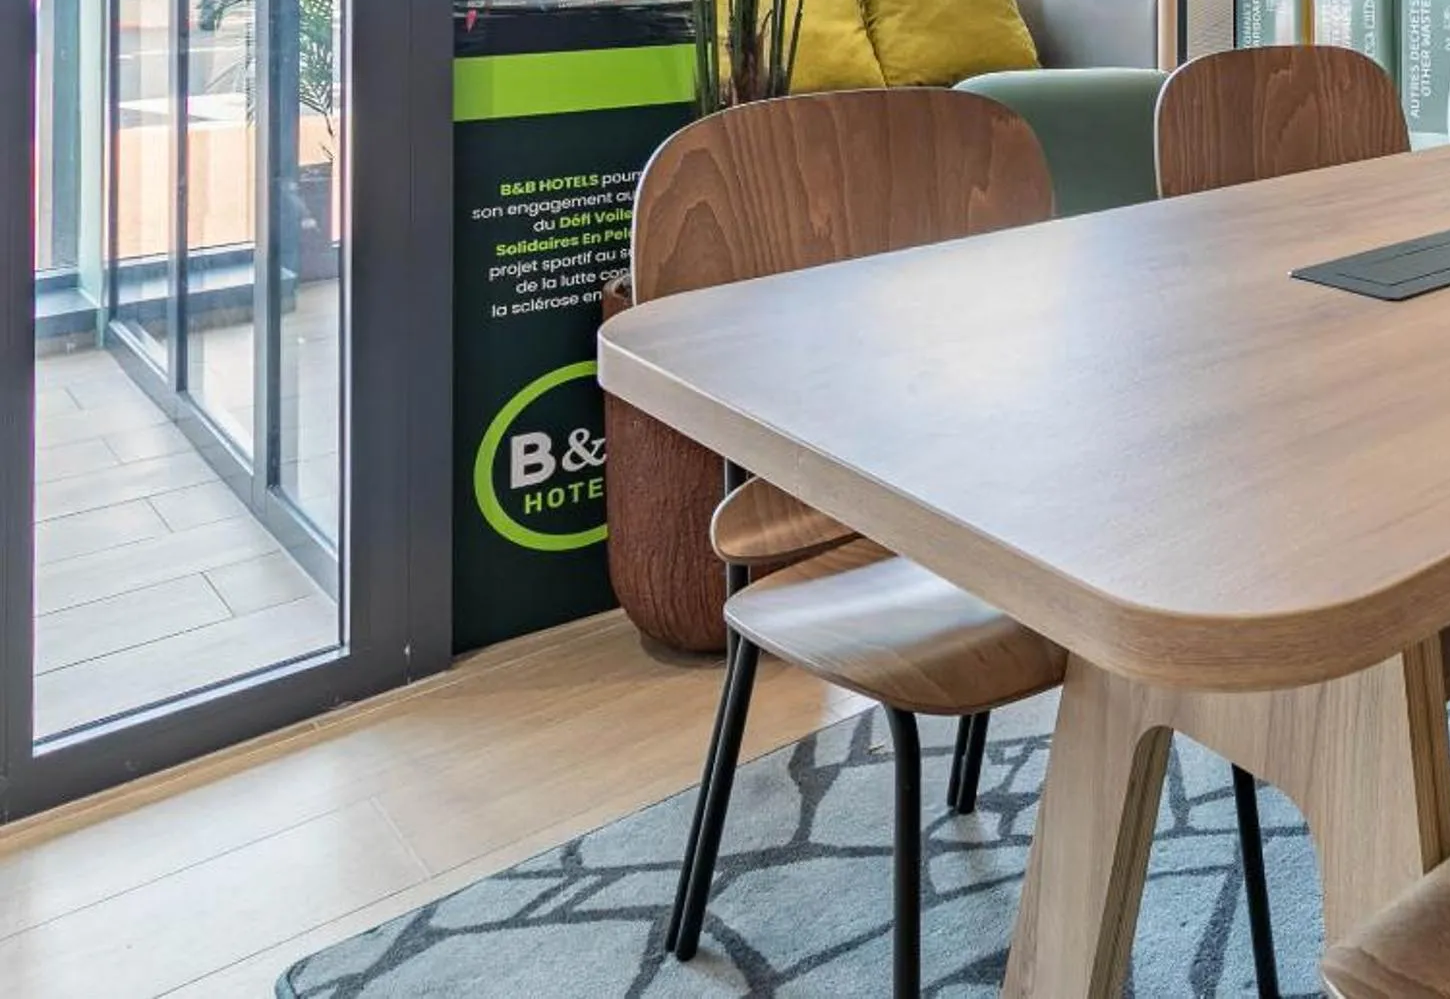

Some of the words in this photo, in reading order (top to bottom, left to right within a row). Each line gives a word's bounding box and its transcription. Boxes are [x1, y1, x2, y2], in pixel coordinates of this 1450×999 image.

[1421, 50, 1432, 97] OTHER
[499, 180, 537, 196] B&B
[538, 174, 599, 192] HOTELS
[471, 206, 504, 220] son
[507, 191, 613, 217] engagement
[532, 219, 556, 232] du
[559, 211, 591, 230] Défi
[593, 208, 633, 224] Voile
[495, 235, 579, 257] Solidaires
[582, 232, 602, 246] En
[488, 259, 538, 282] projet
[541, 250, 593, 273] sportif
[594, 250, 616, 263] au
[515, 280, 538, 294] de
[541, 277, 557, 290] la
[560, 272, 597, 287] lutte
[491, 304, 507, 318] la
[511, 294, 579, 315] sclérose
[583, 290, 602, 302] en
[510, 427, 608, 490] B&
[524, 476, 604, 515] HOTE
